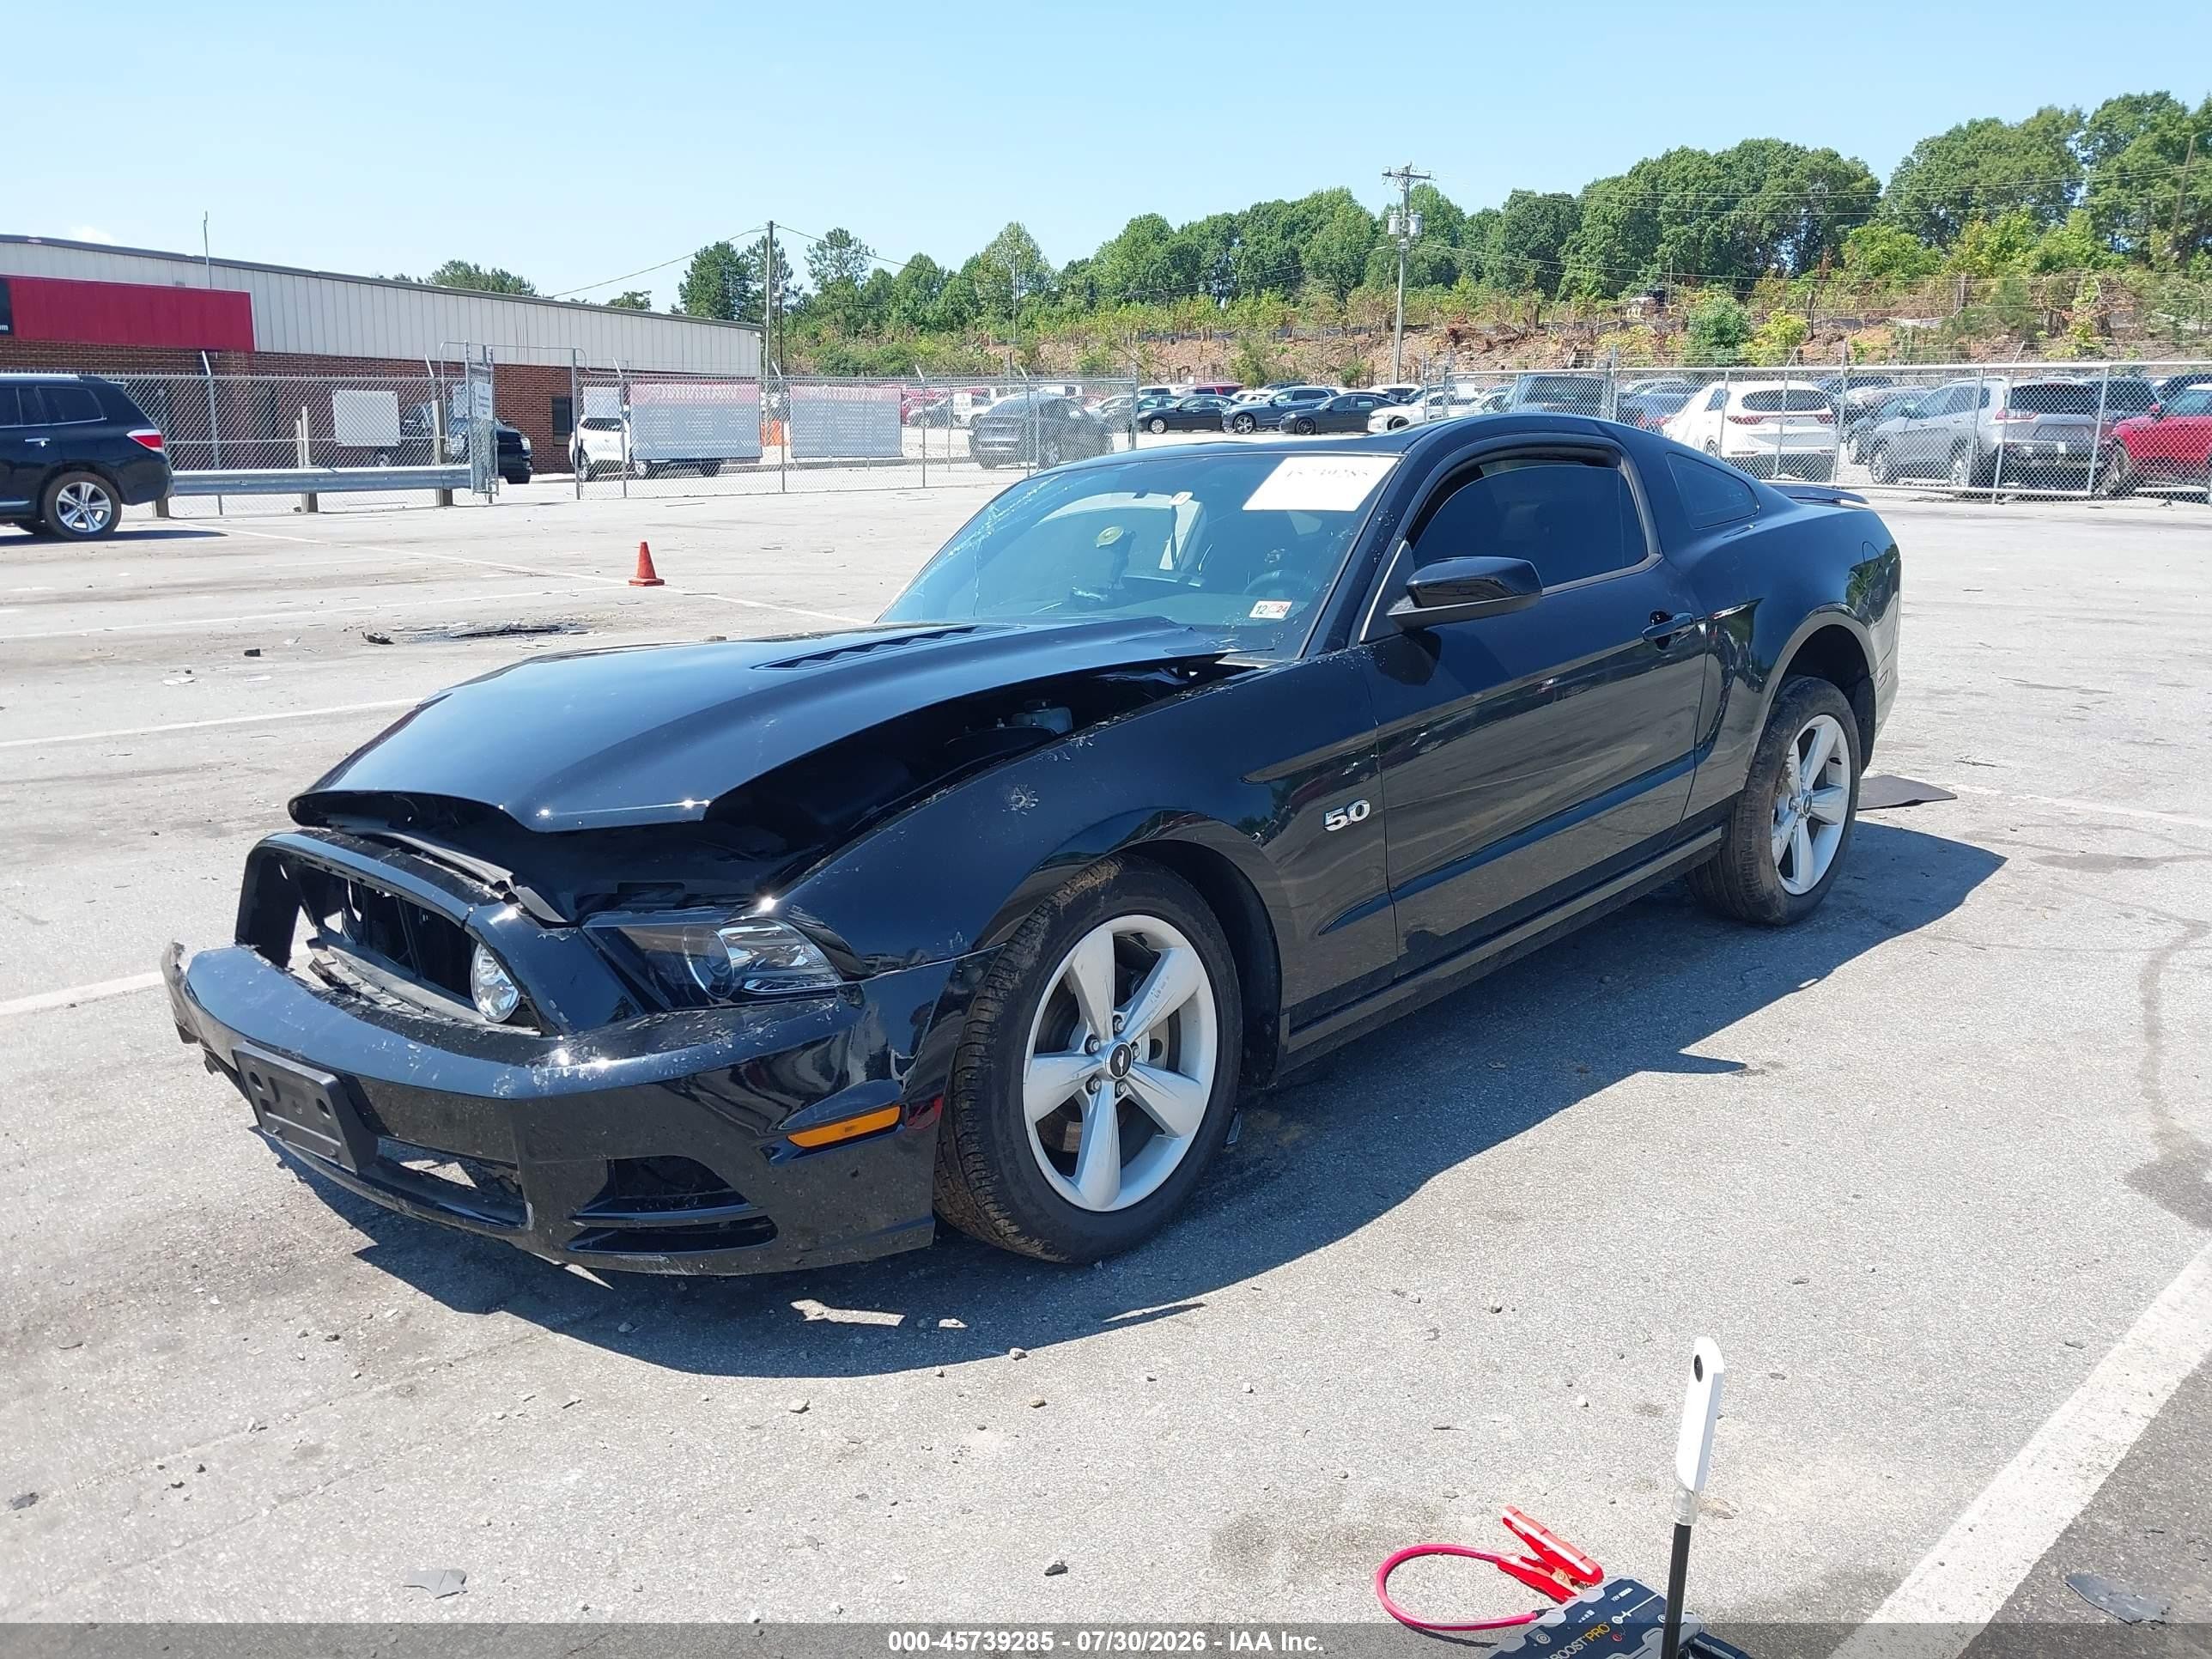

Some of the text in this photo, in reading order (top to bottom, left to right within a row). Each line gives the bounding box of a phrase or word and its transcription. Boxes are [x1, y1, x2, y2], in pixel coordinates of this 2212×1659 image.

[1255, 605, 1268, 615] 12
[1324, 799, 1370, 831] 5.0
[1585, 1623, 1611, 1642] PRO
